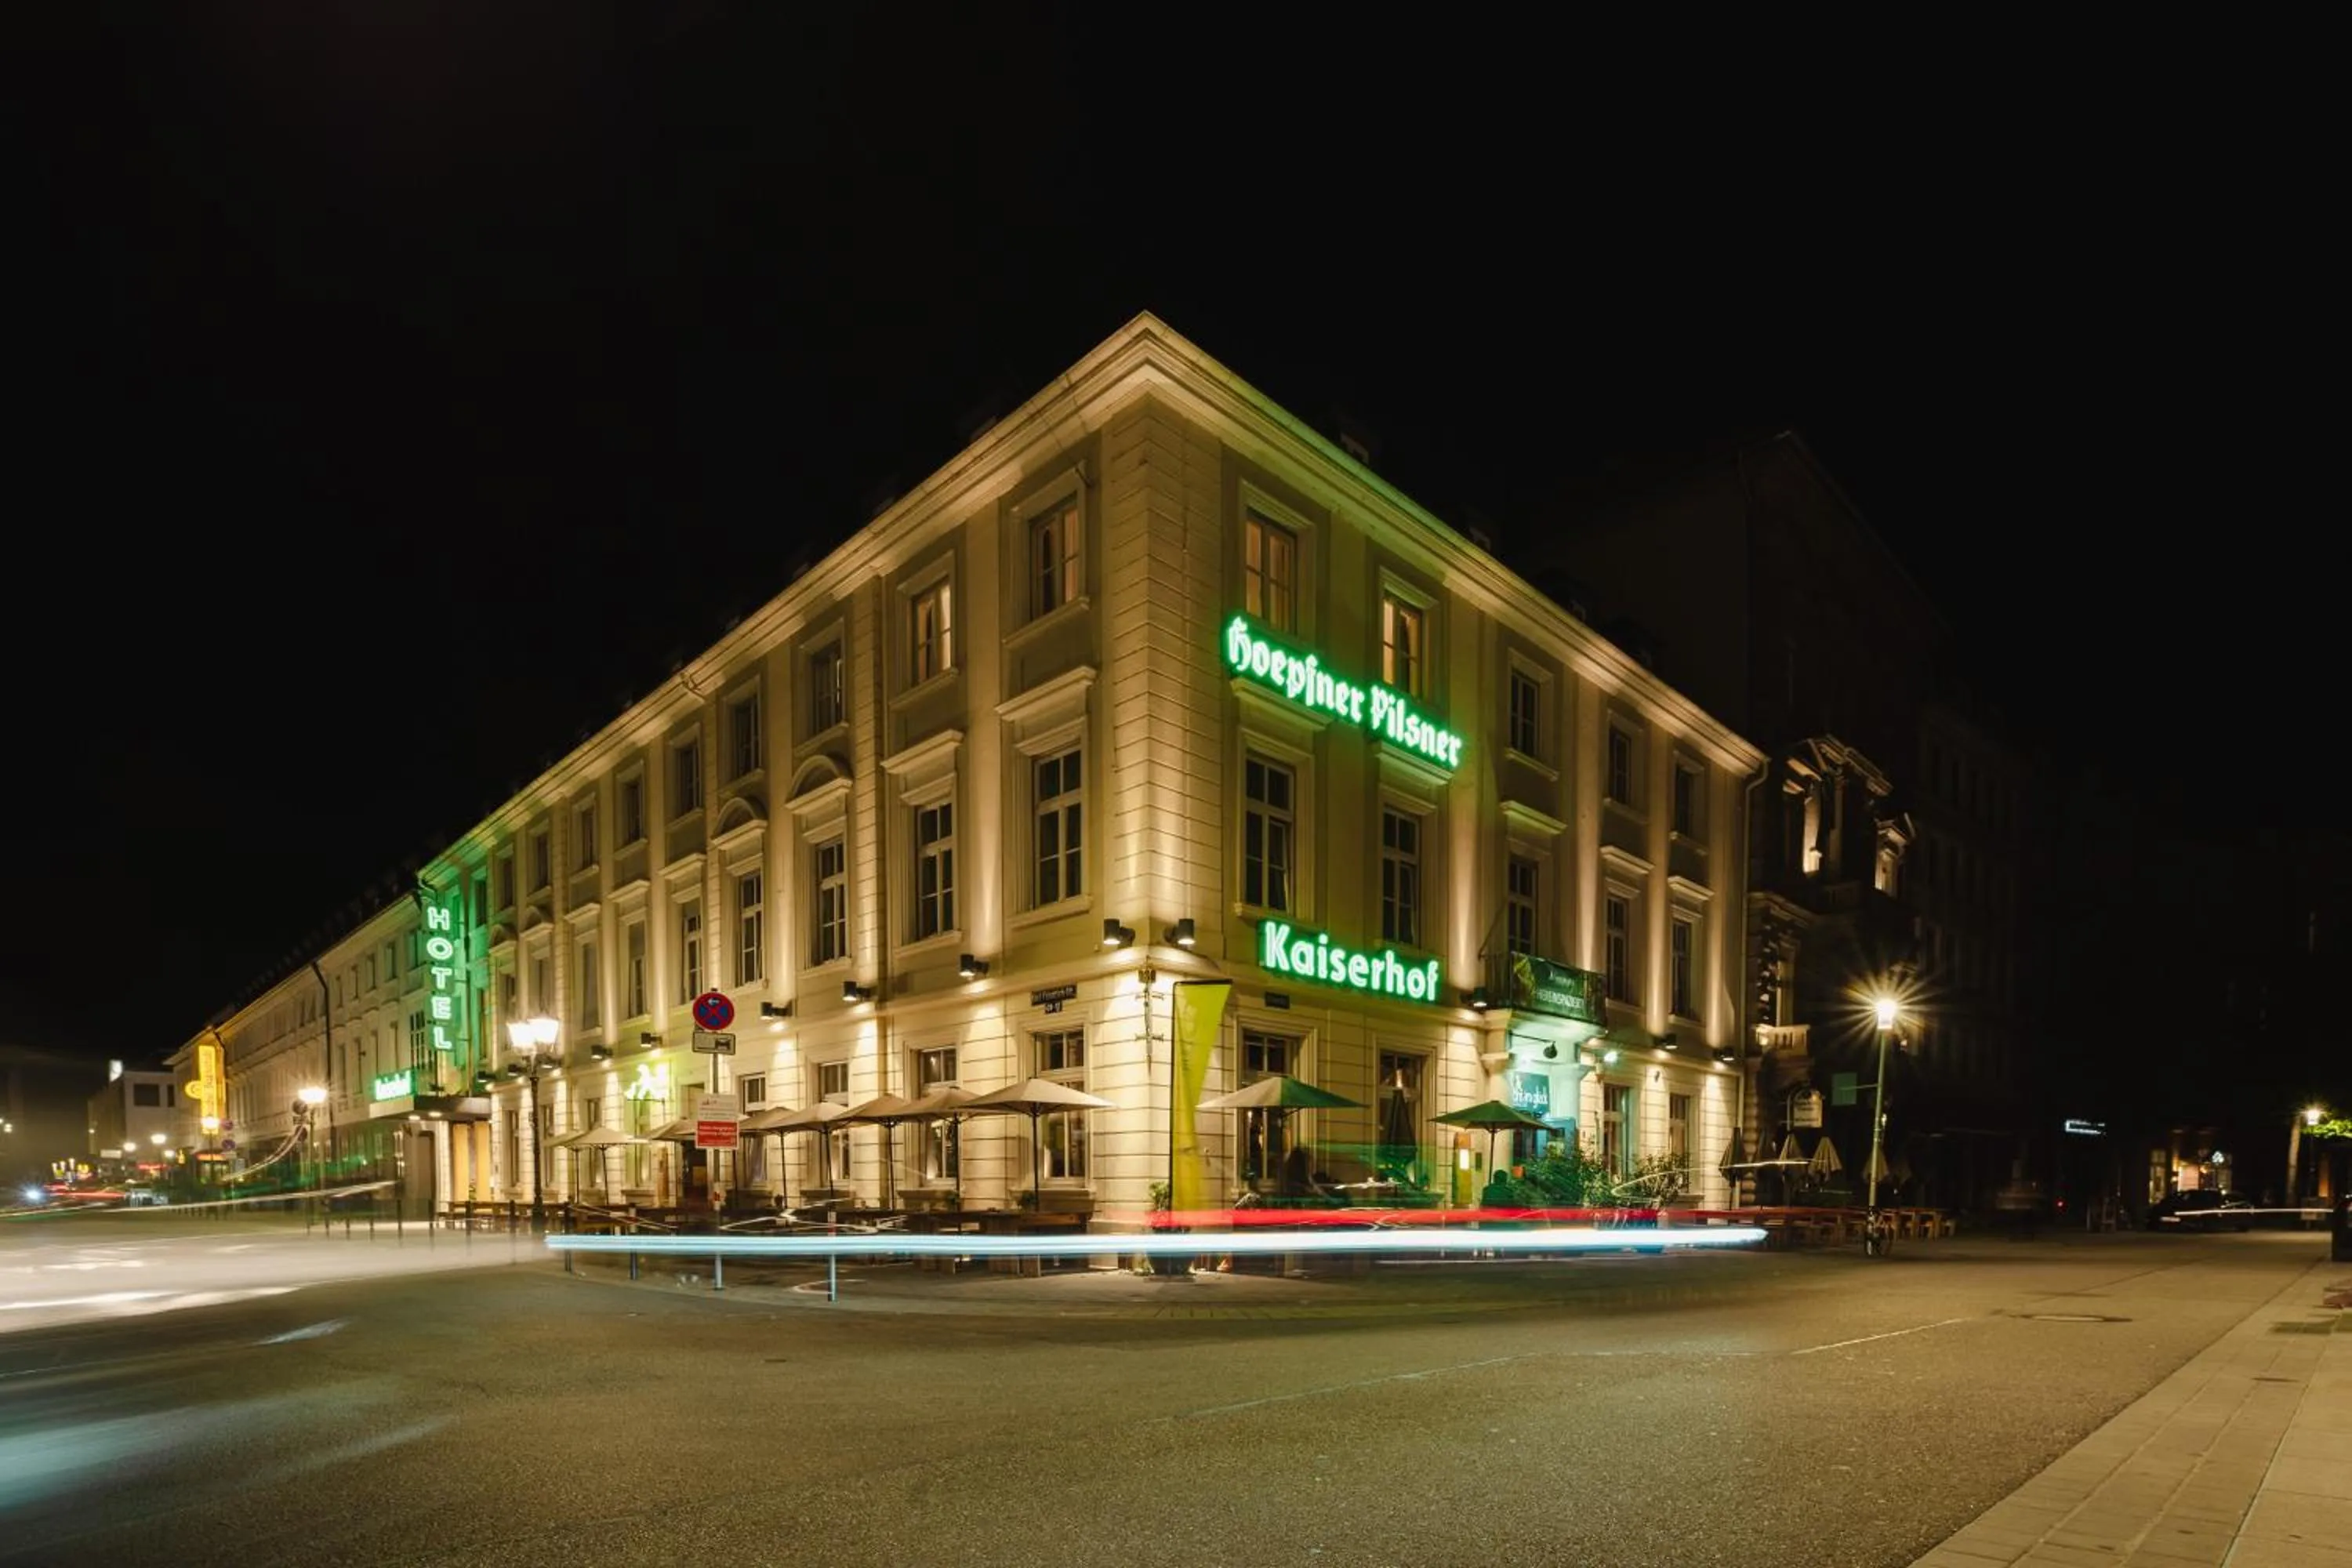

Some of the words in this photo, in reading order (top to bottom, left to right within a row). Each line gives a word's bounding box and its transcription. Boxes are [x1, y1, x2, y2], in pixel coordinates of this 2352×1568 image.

[1229, 616, 1365, 723] Hoepfner
[1370, 685, 1462, 767] Pilsner
[426, 906, 453, 1049] HOTEL
[1265, 921, 1439, 1001] Kaiserhof
